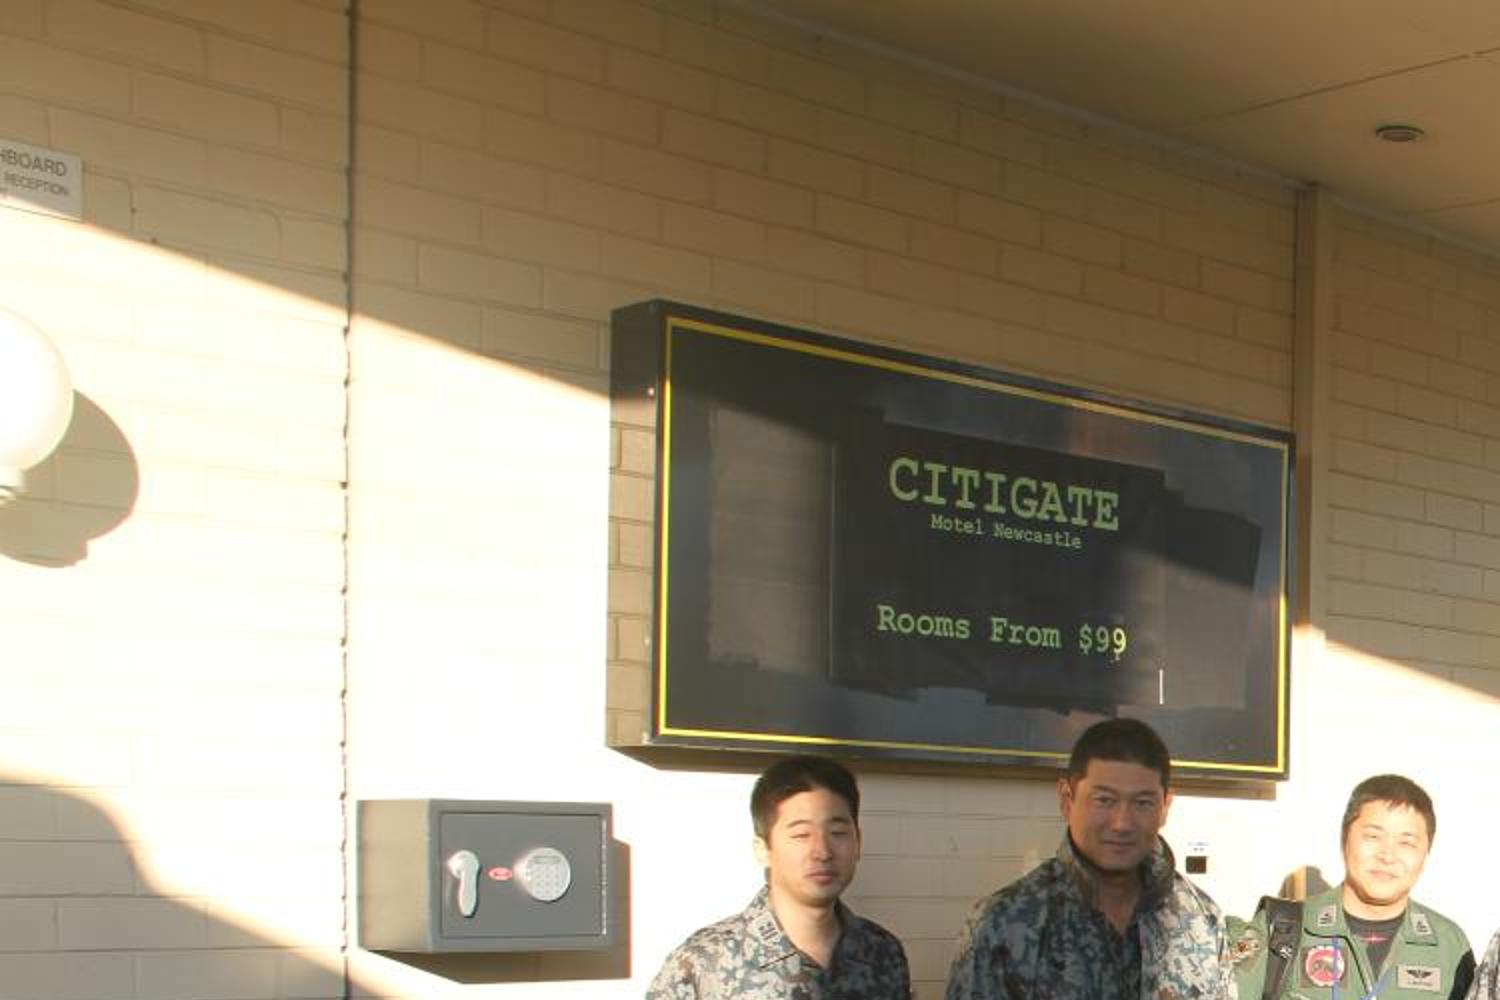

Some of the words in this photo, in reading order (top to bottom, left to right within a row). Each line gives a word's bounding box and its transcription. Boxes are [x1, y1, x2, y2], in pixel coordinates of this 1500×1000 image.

[889, 457, 1120, 531] CITIGATE
[930, 513, 985, 535] Motel
[993, 522, 1083, 549] Newcastle
[877, 604, 971, 640] Rooms
[990, 616, 1062, 649] From
[1079, 622, 1128, 655] $99
